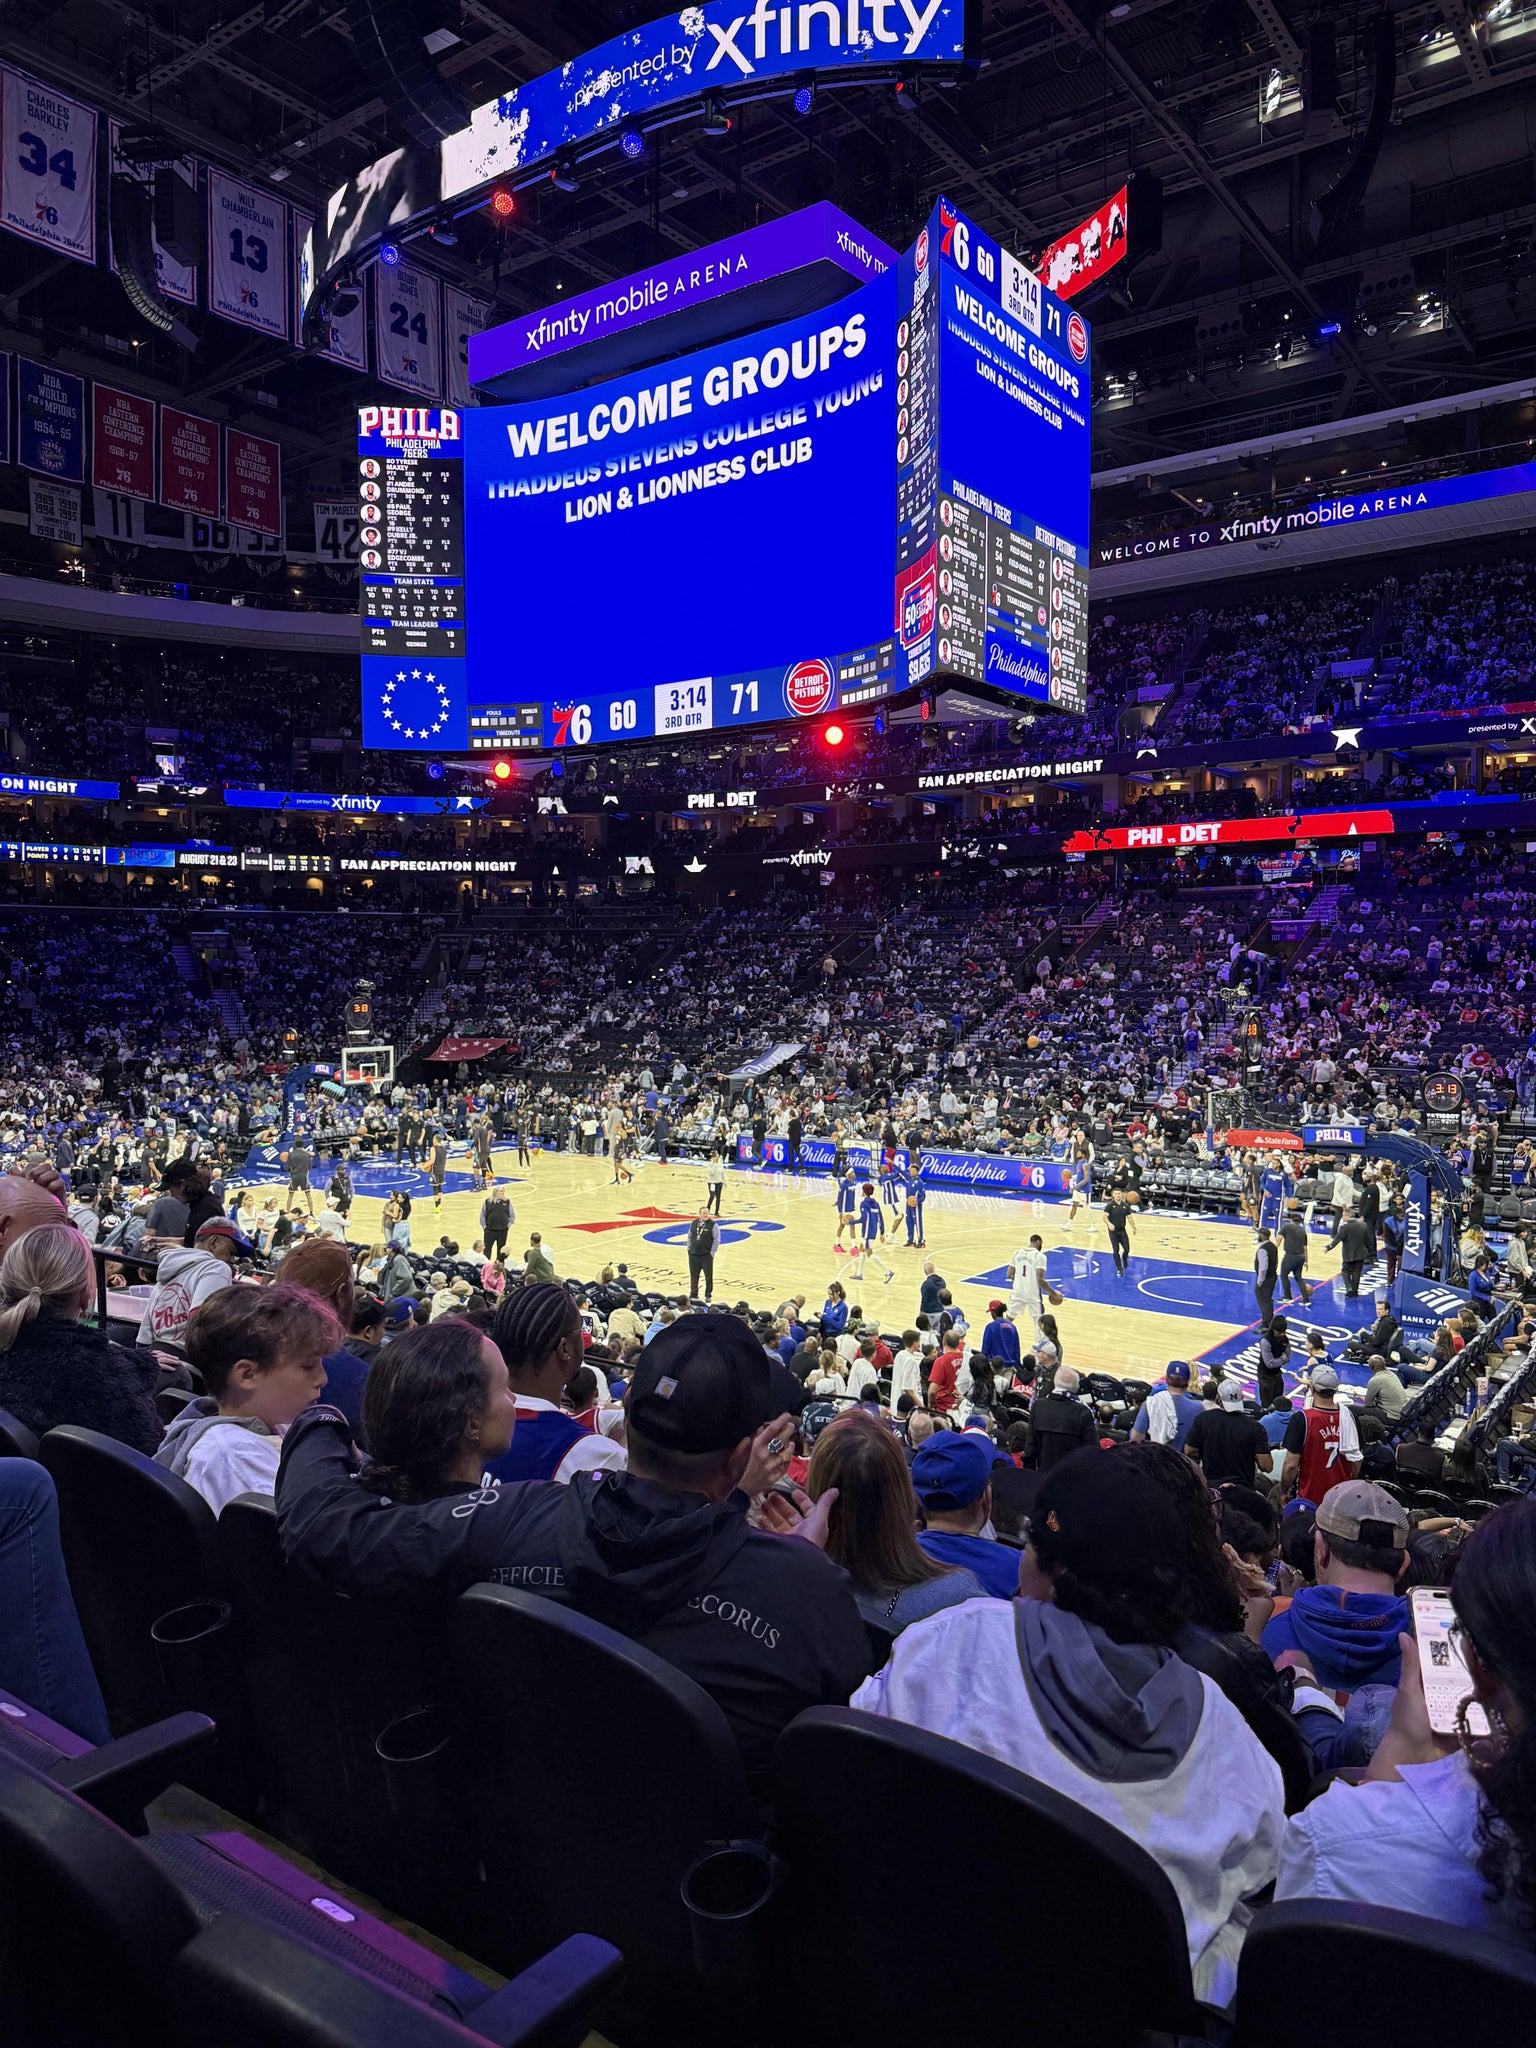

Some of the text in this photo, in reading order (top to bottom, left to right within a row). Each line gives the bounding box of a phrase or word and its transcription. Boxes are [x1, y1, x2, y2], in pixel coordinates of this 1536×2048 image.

[573, 0, 943, 108] presented by xfinity
[27, 90, 69, 121] CHARLES
[28, 105, 69, 132] BARKLEY
[19, 131, 77, 191] 34
[238, 192, 256, 209] WILT
[35, 201, 59, 225] 76
[221, 197, 274, 229] CHAMBERLAIN
[8, 212, 61, 243] Philadelphia
[230, 228, 268, 273] 13
[836, 230, 871, 267] xfinity
[940, 204, 1061, 338] 76 60 3:14 71
[240, 287, 259, 308] 76
[526, 254, 748, 352] xfinity mobile ARENA
[218, 300, 261, 324] Philadelphia
[1008, 294, 1035, 327] 3RD QTR
[389, 301, 428, 346] 24
[955, 284, 1079, 399] WELCOME GROUPS
[402, 358, 418, 374] 76
[43, 373, 62, 390] NBA
[507, 375, 694, 459] WELCOME
[702, 313, 867, 407] GROUPS
[37, 384, 68, 404] WORLD
[976, 358, 1062, 430] LION & LIONNESS CLUB
[108, 405, 139, 424] EASTERN
[116, 398, 131, 412] NBA
[33, 419, 72, 441] 1954-55
[102, 414, 146, 437] CONFERENCE
[184, 420, 198, 432] NBA
[358, 406, 460, 441] PHILA
[486, 369, 884, 499] THADDEUS STEVENS COLLEGE YOUNG
[104, 425, 144, 445] CHAMPIONS
[177, 427, 207, 445] EASTERN
[385, 438, 441, 450] PHILADELPHIA
[171, 436, 212, 457] CONFERENCE
[173, 446, 210, 465] CHAMPIONS
[239, 448, 267, 465] EASTERN
[246, 441, 260, 453] NBA
[403, 448, 428, 458] 76ERS
[117, 468, 132, 483] 76
[234, 457, 272, 476] CONFERENCE
[236, 467, 271, 485] CHAMPIONS
[565, 436, 813, 524] LION & LIONNESS CLUB
[184, 487, 199, 502] 76
[953, 479, 993, 515] PHILADELPHIA
[993, 499, 1012, 525] 76ERS
[246, 506, 260, 520] 76
[315, 504, 331, 515] TOM
[1100, 492, 1428, 562] WELCOME TO xfinity mobile ARENA
[321, 518, 360, 559] 42
[1035, 525, 1077, 560] DETROIT PISTONS
[393, 577, 412, 585] TEAM
[411, 620, 438, 628] LEADERS
[904, 603, 917, 628] 50
[987, 642, 1048, 688] Philadelphia
[794, 673, 824, 689] DETROIT
[794, 684, 824, 699] PISTONS
[485, 709, 503, 717] FOULS
[552, 680, 760, 748] 76 60 3:14 71
[665, 712, 702, 730] 3RD QTR
[1468, 722, 1518, 735] presented by
[918, 759, 1104, 789] FAN APPRECIATION NIGHT
[28, 779, 78, 794] NIGHT
[331, 794, 382, 812] xfinity
[688, 791, 757, 809] PHI DET
[1128, 823, 1222, 846] PHI DET
[179, 853, 209, 866] AUGUST
[209, 854, 219, 866] 21
[219, 855, 226, 866] &
[227, 855, 238, 866] 23
[340, 859, 369, 870] FAN
[371, 859, 475, 872] APPRECIATION
[475, 861, 518, 872] NIGHT
[790, 849, 832, 866] xfinity
[1435, 1083, 1457, 1094] 3:13
[1315, 1129, 1353, 1143] PHILA
[764, 1142, 1046, 1188] 76 Philadelphia 76
[1404, 1200, 1426, 1257] xfinity
[154, 1305, 188, 1331] 76ers
[1401, 1314, 1424, 1324] BANK
[1324, 1441, 1340, 1469] 7
